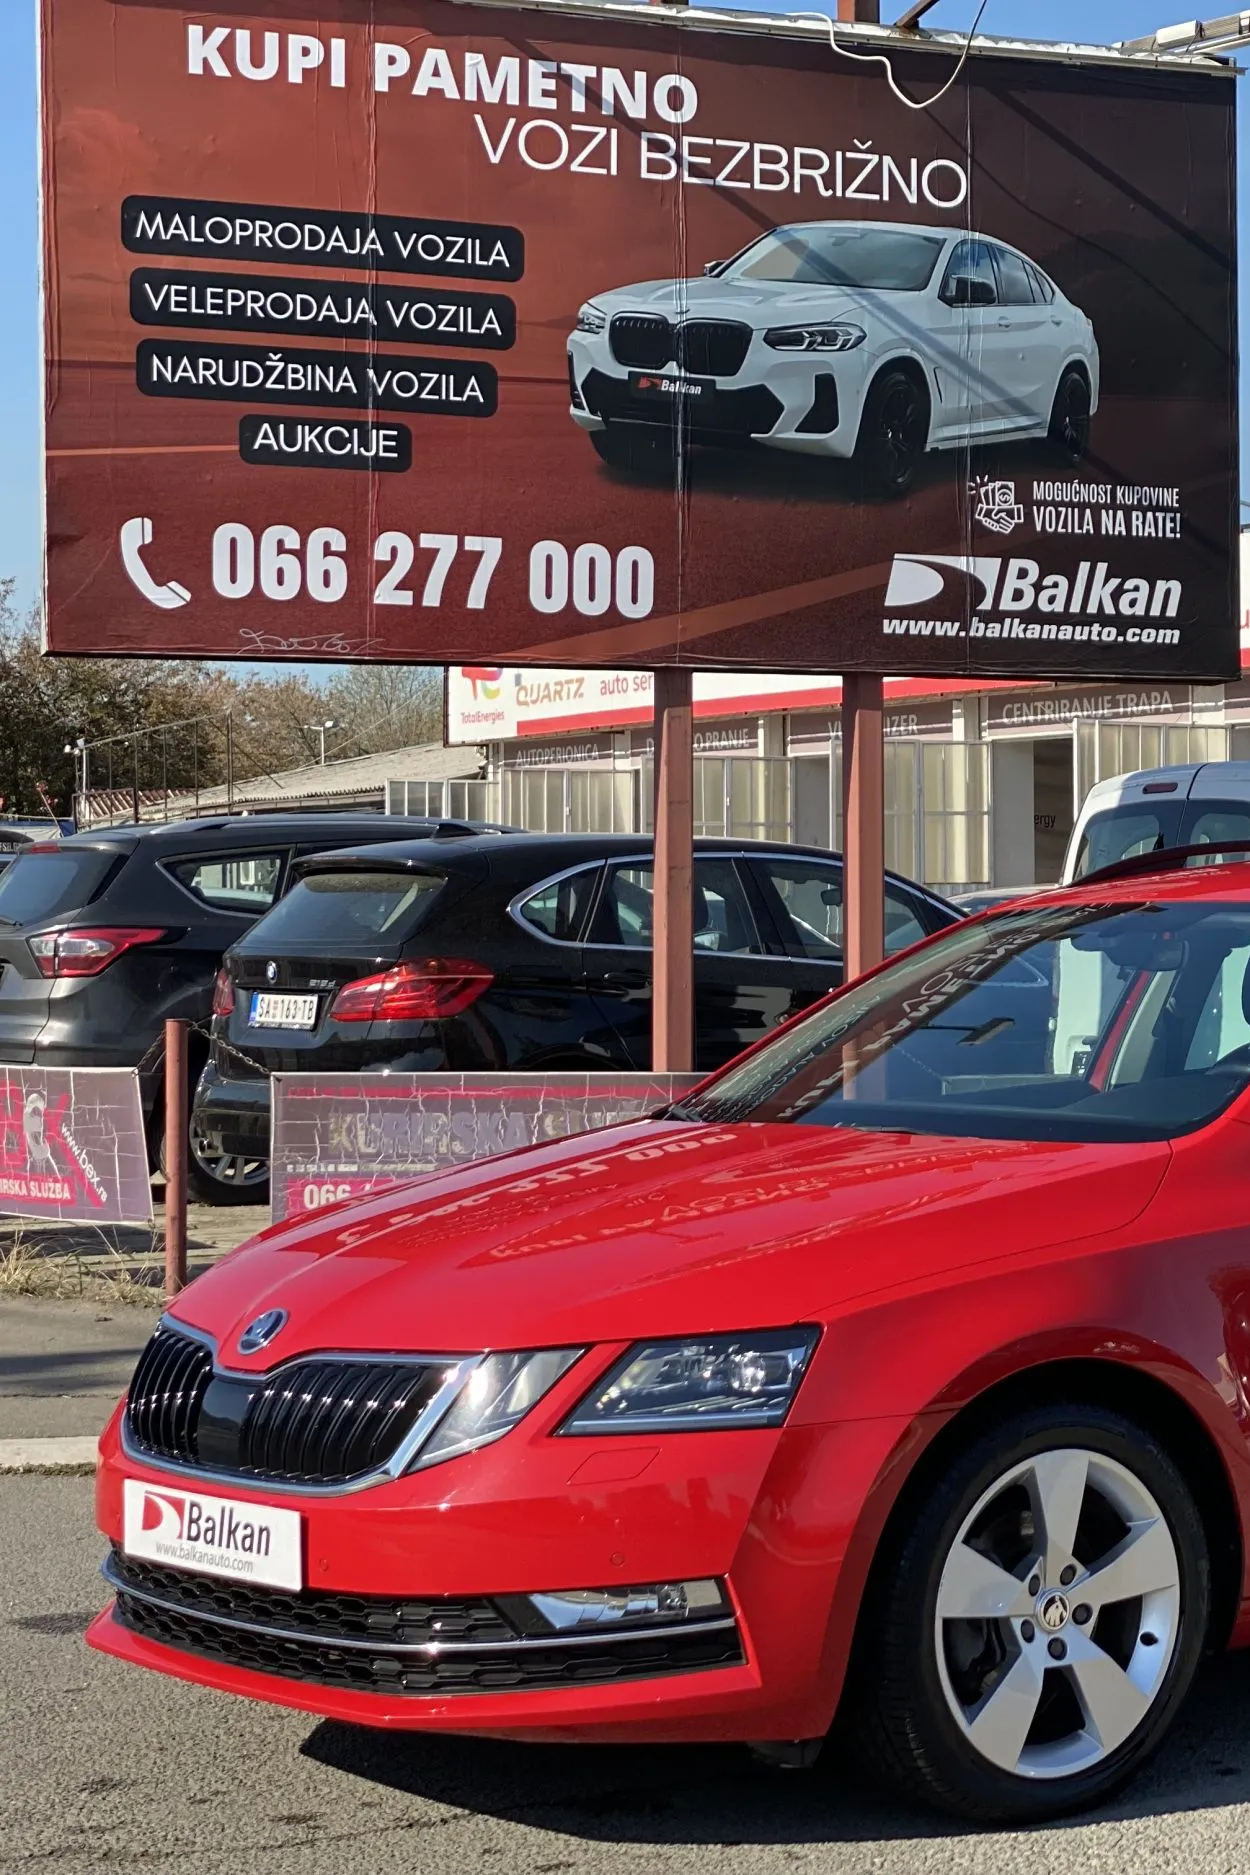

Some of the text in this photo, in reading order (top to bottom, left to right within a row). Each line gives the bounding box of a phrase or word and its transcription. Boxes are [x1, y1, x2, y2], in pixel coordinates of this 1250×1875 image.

[187, 24, 698, 124] KUPI PAMETNO
[474, 113, 968, 208] VOZI BEZBRIŽNO
[135, 210, 510, 267] MALOPRODAJA VOZILA
[143, 282, 502, 335] VELEPRODAJA VOZILA
[152, 352, 484, 402] NARUDŽBINA VOZILA
[661, 380, 702, 394] Balkan
[252, 422, 398, 457] AUKCIJE
[1032, 477, 1180, 508] MOGUĆNOST KUPOVINE
[1032, 505, 1181, 538] VOZILA NA RATE!
[212, 522, 655, 618] 066 277 000
[999, 557, 1182, 617] Balkan
[882, 616, 1180, 644] www.balkanauto.com
[516, 677, 585, 708] QUARTZ
[600, 679, 629, 696] auto
[460, 709, 505, 724] TotalEnergies
[1002, 690, 1174, 725] CENTRIRANJE TRAPA
[516, 743, 599, 766] AUTOPERIONICA
[705, 728, 750, 750] PRANJE
[1034, 814, 1056, 828] ergy
[259, 997, 271, 1018] SA
[30, 1178, 71, 1200] SLUŽBA
[186, 1500, 271, 1556] Balkan
[155, 1540, 254, 1573] www.balkanauto.com
